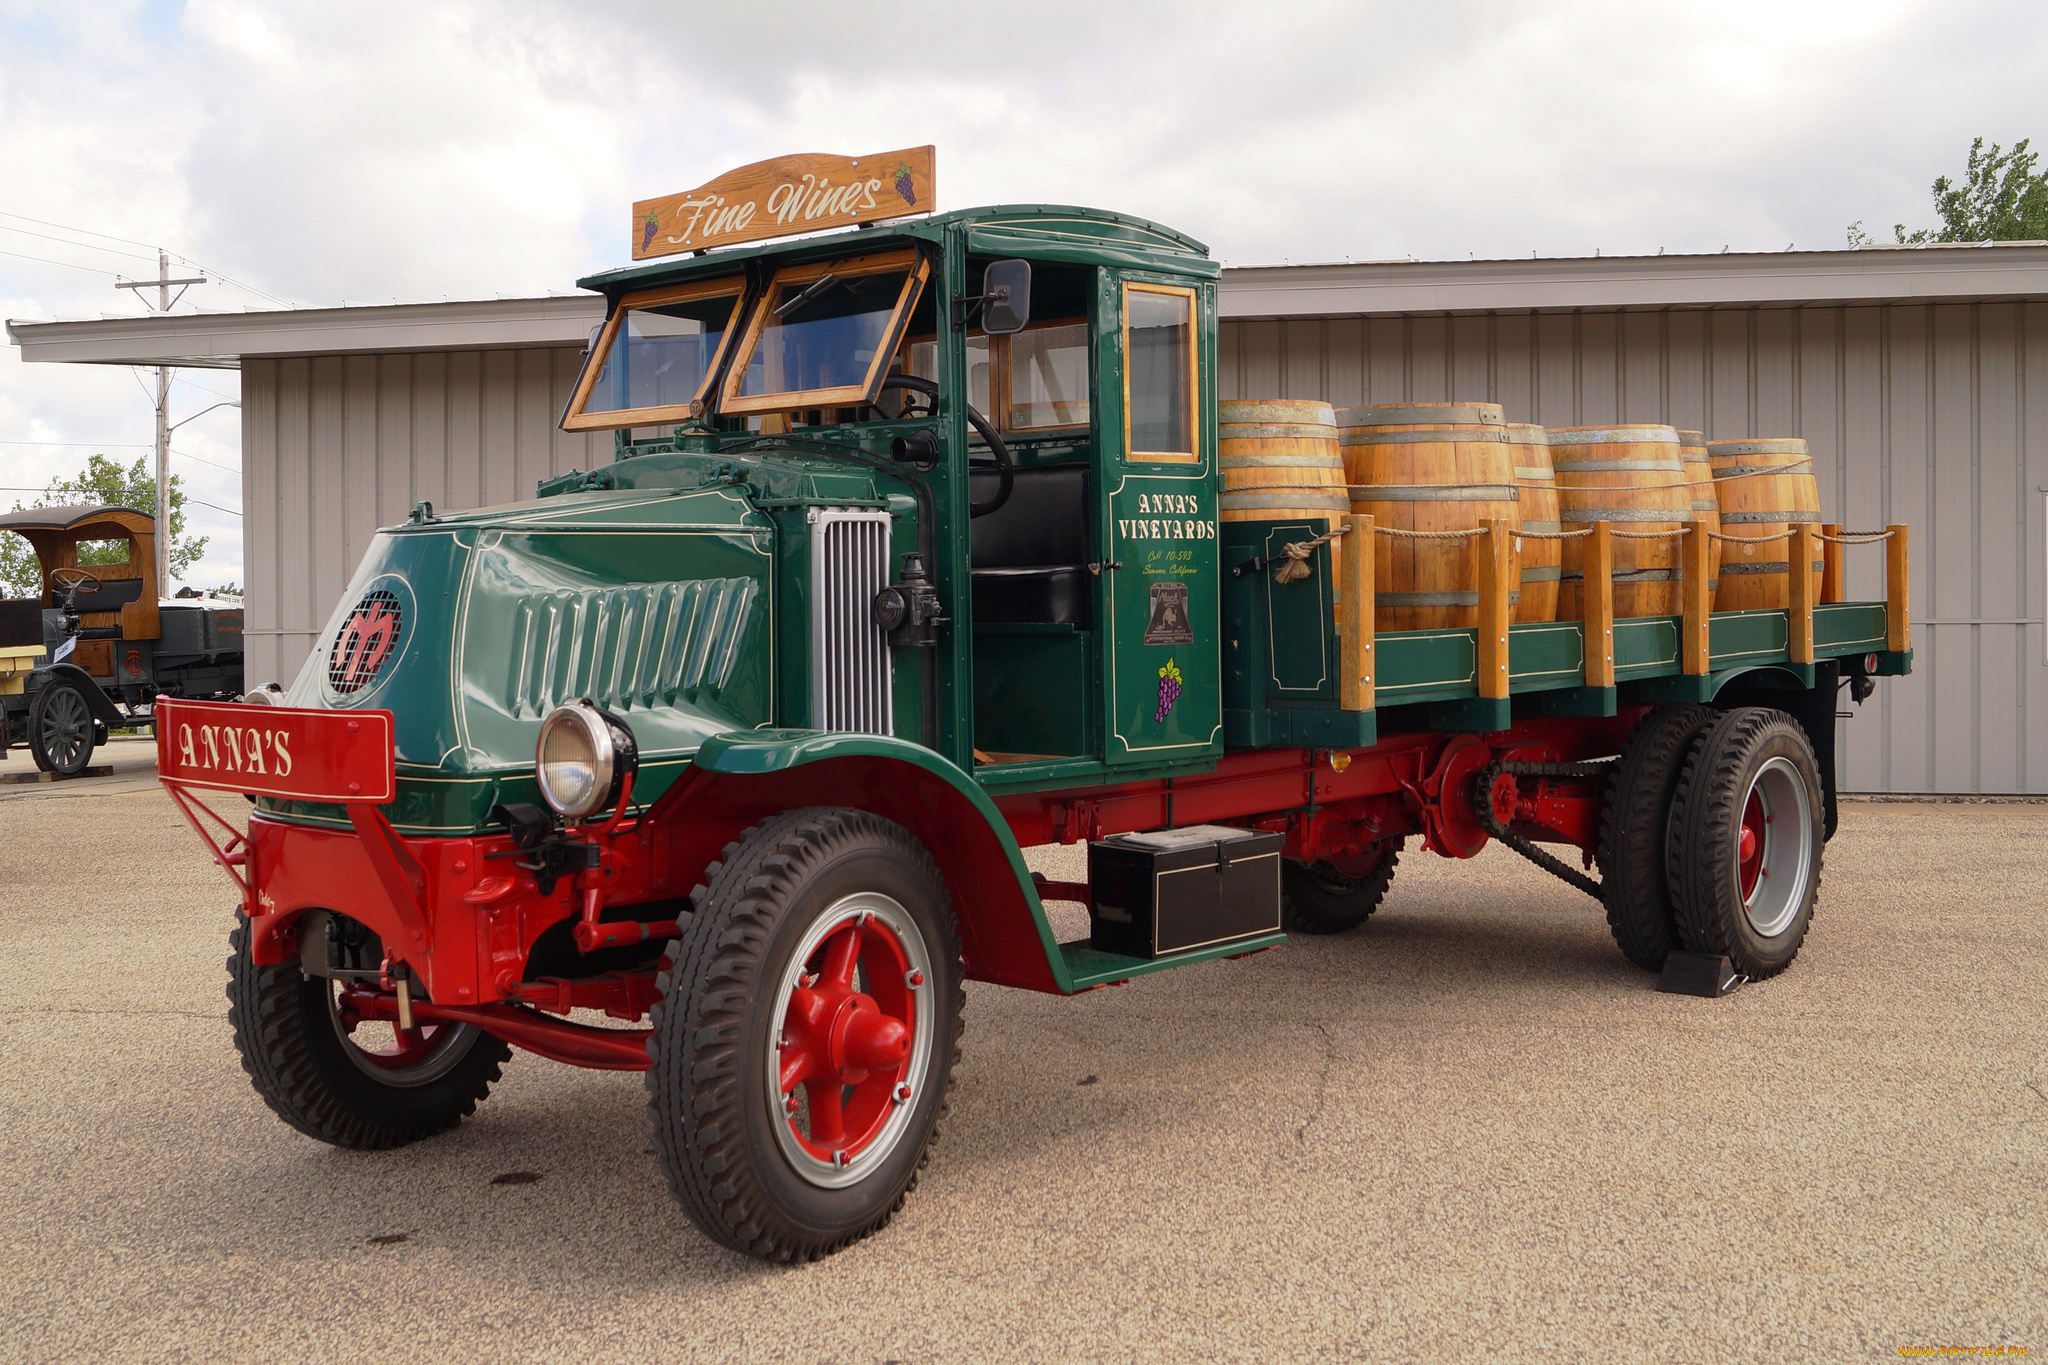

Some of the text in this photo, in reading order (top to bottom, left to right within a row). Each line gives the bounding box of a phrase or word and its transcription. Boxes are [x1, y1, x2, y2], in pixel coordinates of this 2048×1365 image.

[667, 173, 882, 245] Fine Wines
[1138, 493, 1198, 514] ANNA'S
[1118, 519, 1215, 540] VINEYARDS
[1147, 550, 1193, 562] Call 10-593
[1169, 563, 1198, 578] California
[178, 722, 293, 778] ANNA'S
